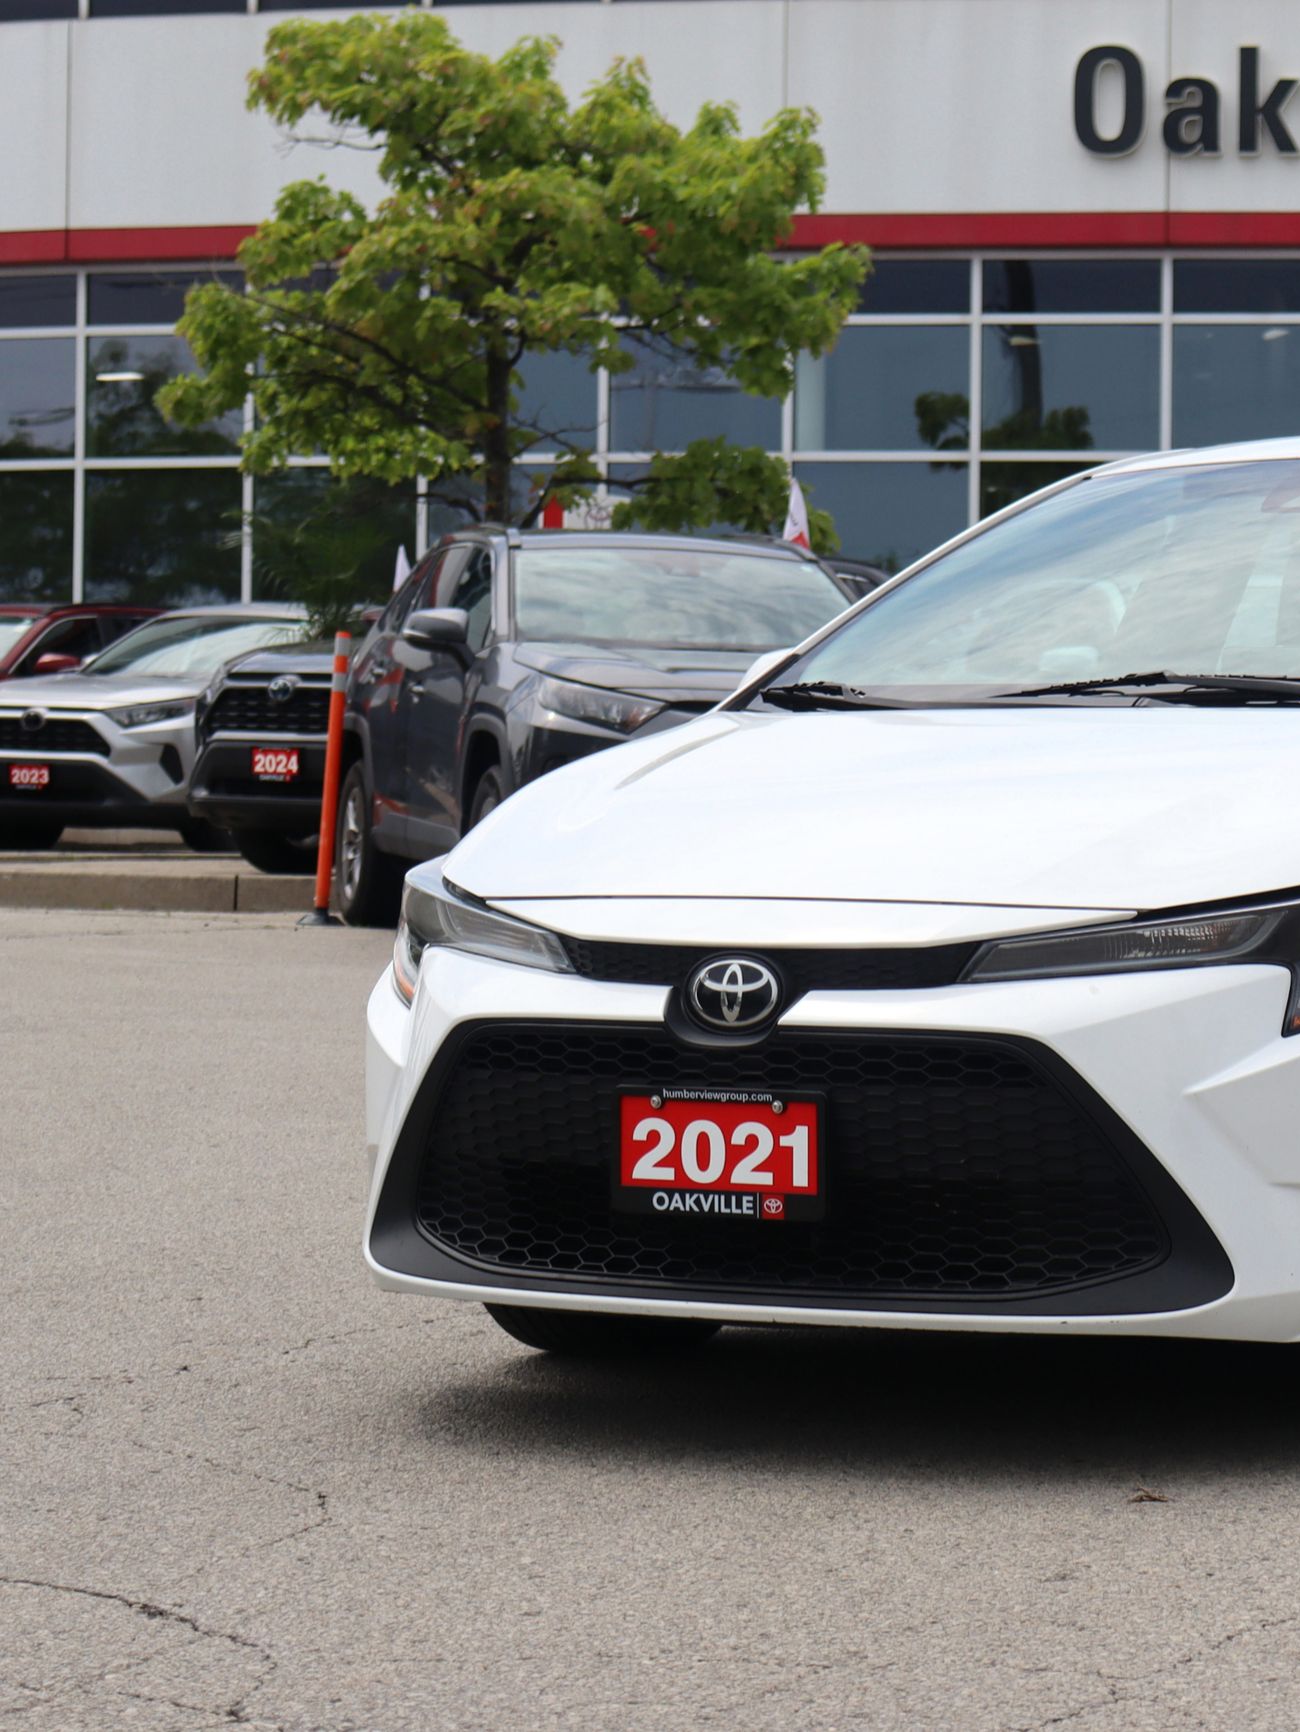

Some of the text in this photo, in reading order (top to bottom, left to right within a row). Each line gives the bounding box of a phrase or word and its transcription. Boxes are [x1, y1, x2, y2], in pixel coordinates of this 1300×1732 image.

[254, 753, 298, 774] 2024
[11, 768, 49, 784] 2023
[662, 1088, 773, 1103] humberviewgroup.com
[631, 1117, 809, 1188] 2021
[652, 1191, 755, 1215] OAKVILLE
